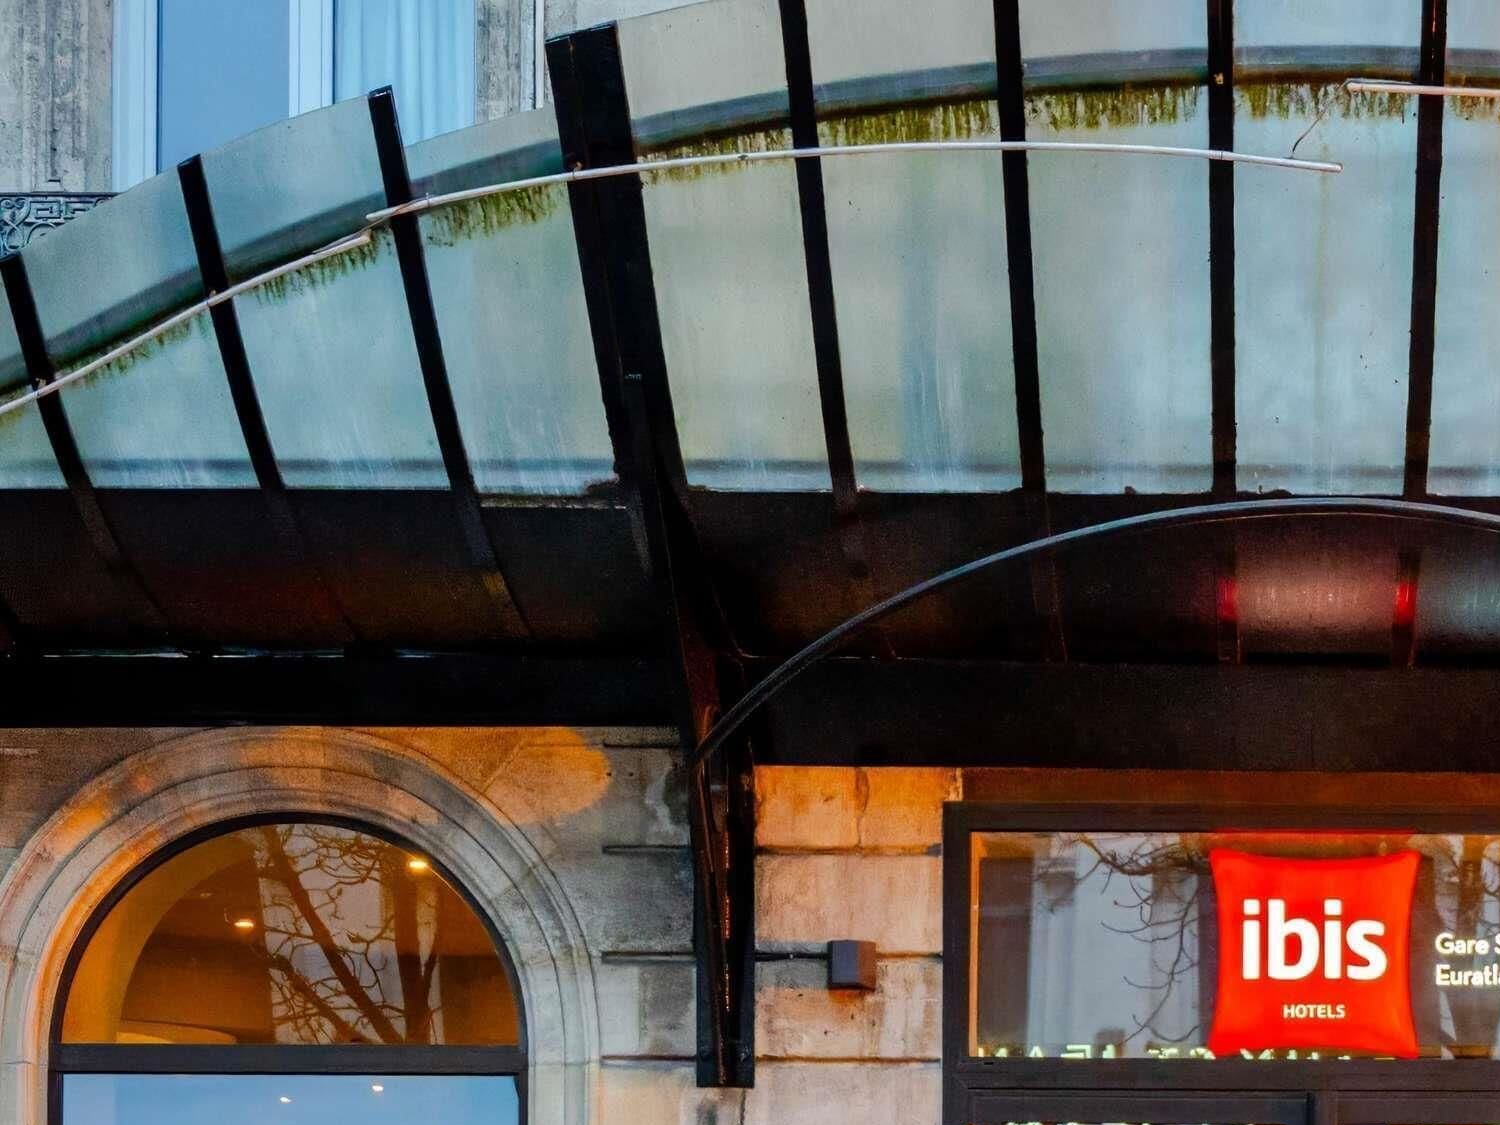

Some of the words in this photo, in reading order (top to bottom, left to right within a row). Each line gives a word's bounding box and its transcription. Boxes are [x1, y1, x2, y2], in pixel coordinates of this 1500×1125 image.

[1242, 898, 1388, 981] ibis
[1435, 932, 1490, 955] Gare
[1283, 1004, 1346, 1019] HOTELS
